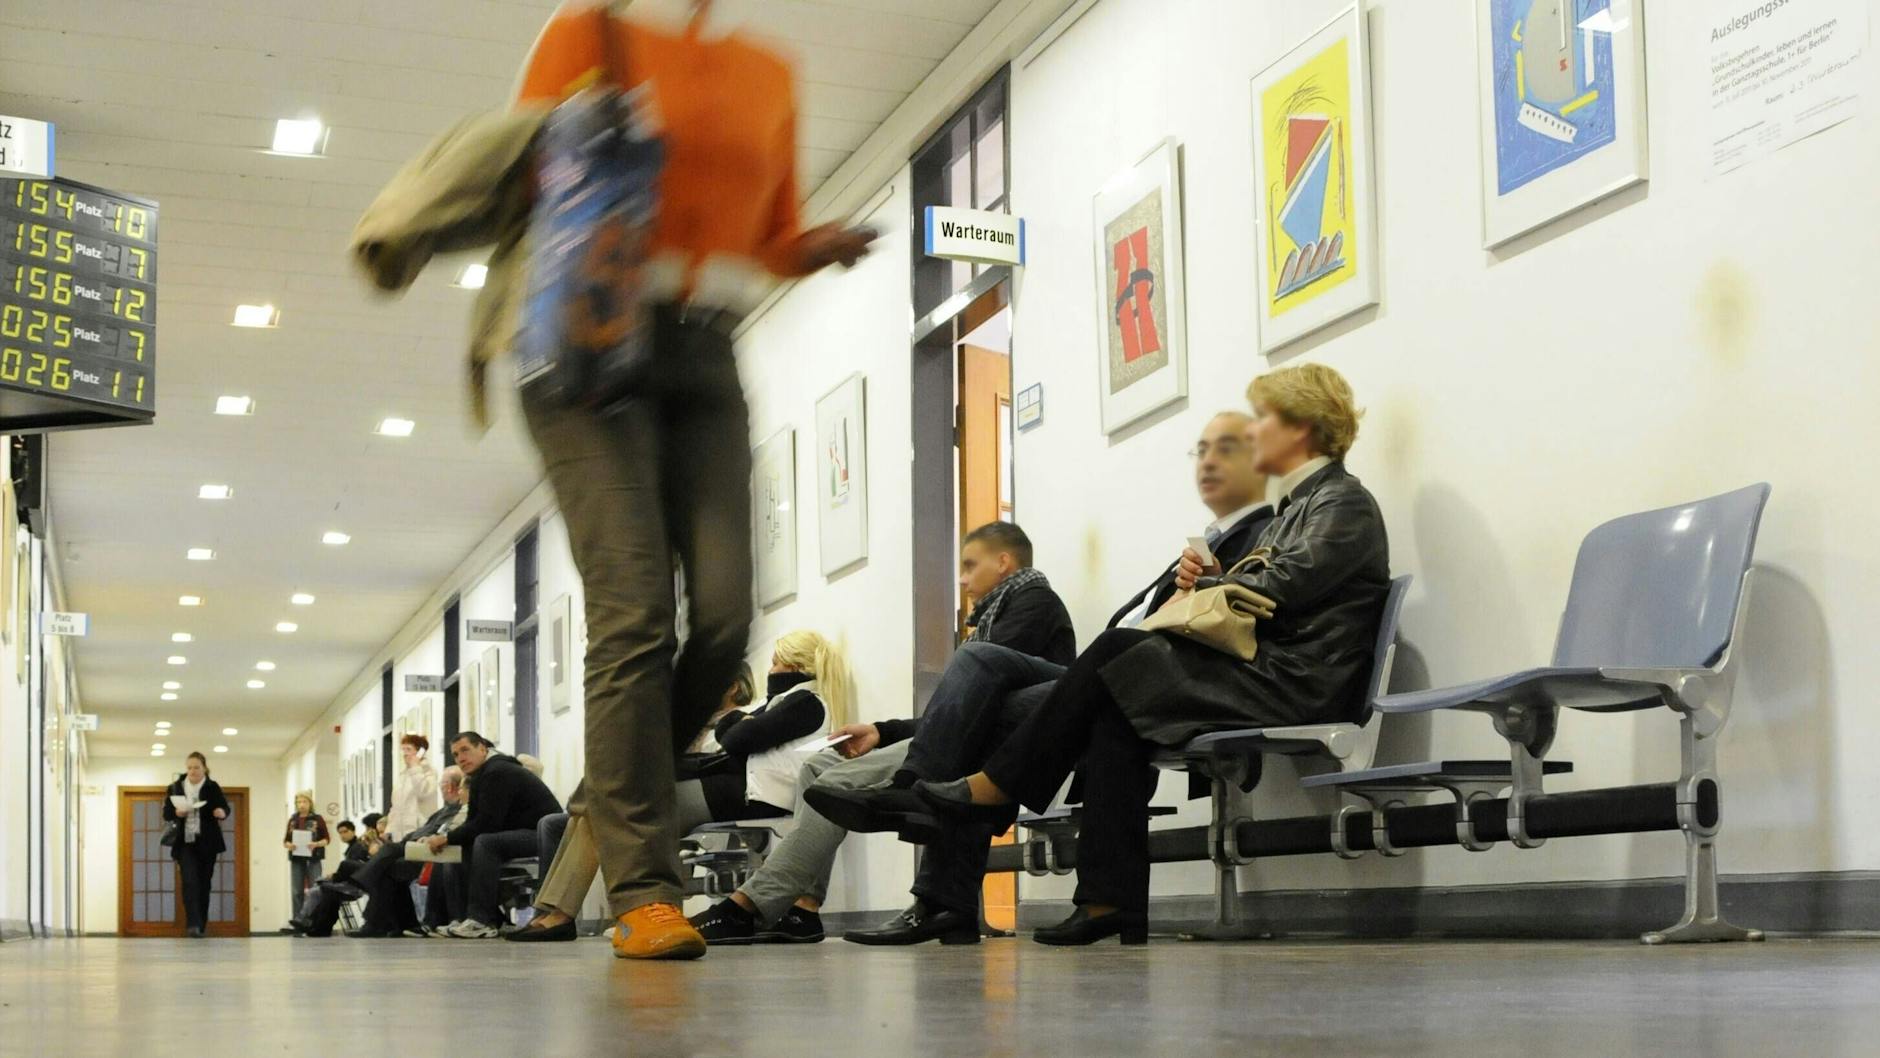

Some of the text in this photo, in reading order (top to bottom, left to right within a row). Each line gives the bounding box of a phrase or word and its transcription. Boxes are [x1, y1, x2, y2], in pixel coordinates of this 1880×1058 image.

[1711, 0, 1789, 43] Auslegungss
[1798, 29, 1812, 43] und
[1813, 18, 1837, 37] lernen
[16, 181, 146, 239] 154 Platz 10
[941, 221, 1014, 246] Warteraum
[16, 223, 146, 279] 155 Platz 7
[15, 265, 145, 321] 156 Platz 12
[1, 304, 145, 362] 025 Platz 7
[0, 348, 145, 402] 026 Platz 11
[473, 625, 507, 635] Warteraum
